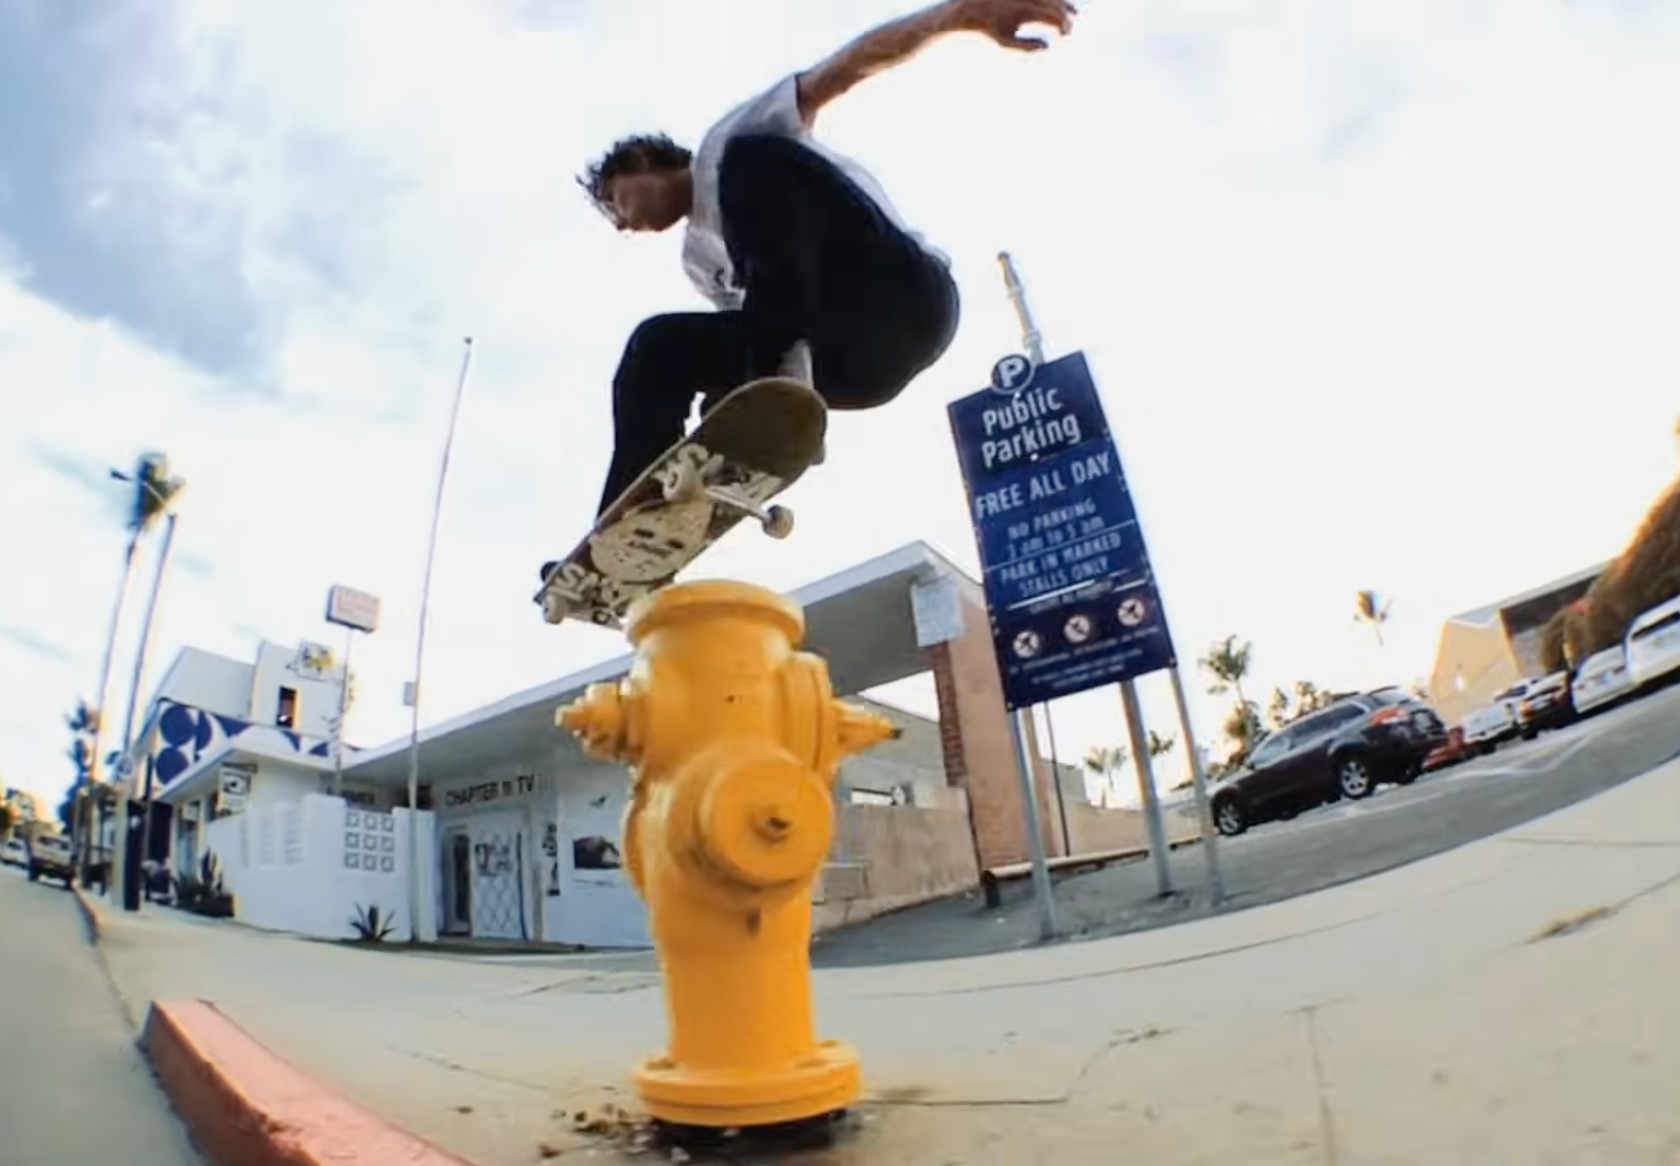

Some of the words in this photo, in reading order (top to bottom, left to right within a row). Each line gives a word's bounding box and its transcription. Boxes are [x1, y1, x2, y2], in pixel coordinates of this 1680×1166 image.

[999, 357, 1024, 388] P
[982, 387, 1064, 436] Public
[981, 413, 1082, 469] Parking
[975, 483, 1025, 519] FREE
[1029, 470, 1067, 501] ALL
[1070, 451, 1112, 484] DAY
[1007, 521, 1030, 541] NO
[1033, 497, 1097, 532] PARKING
[1080, 515, 1106, 533] am
[1000, 560, 1039, 585] PARK
[1040, 553, 1059, 573] IN
[1061, 532, 1122, 562] MARKED
[1018, 568, 1069, 598] STALLS
[1071, 554, 1110, 581] ONLY
